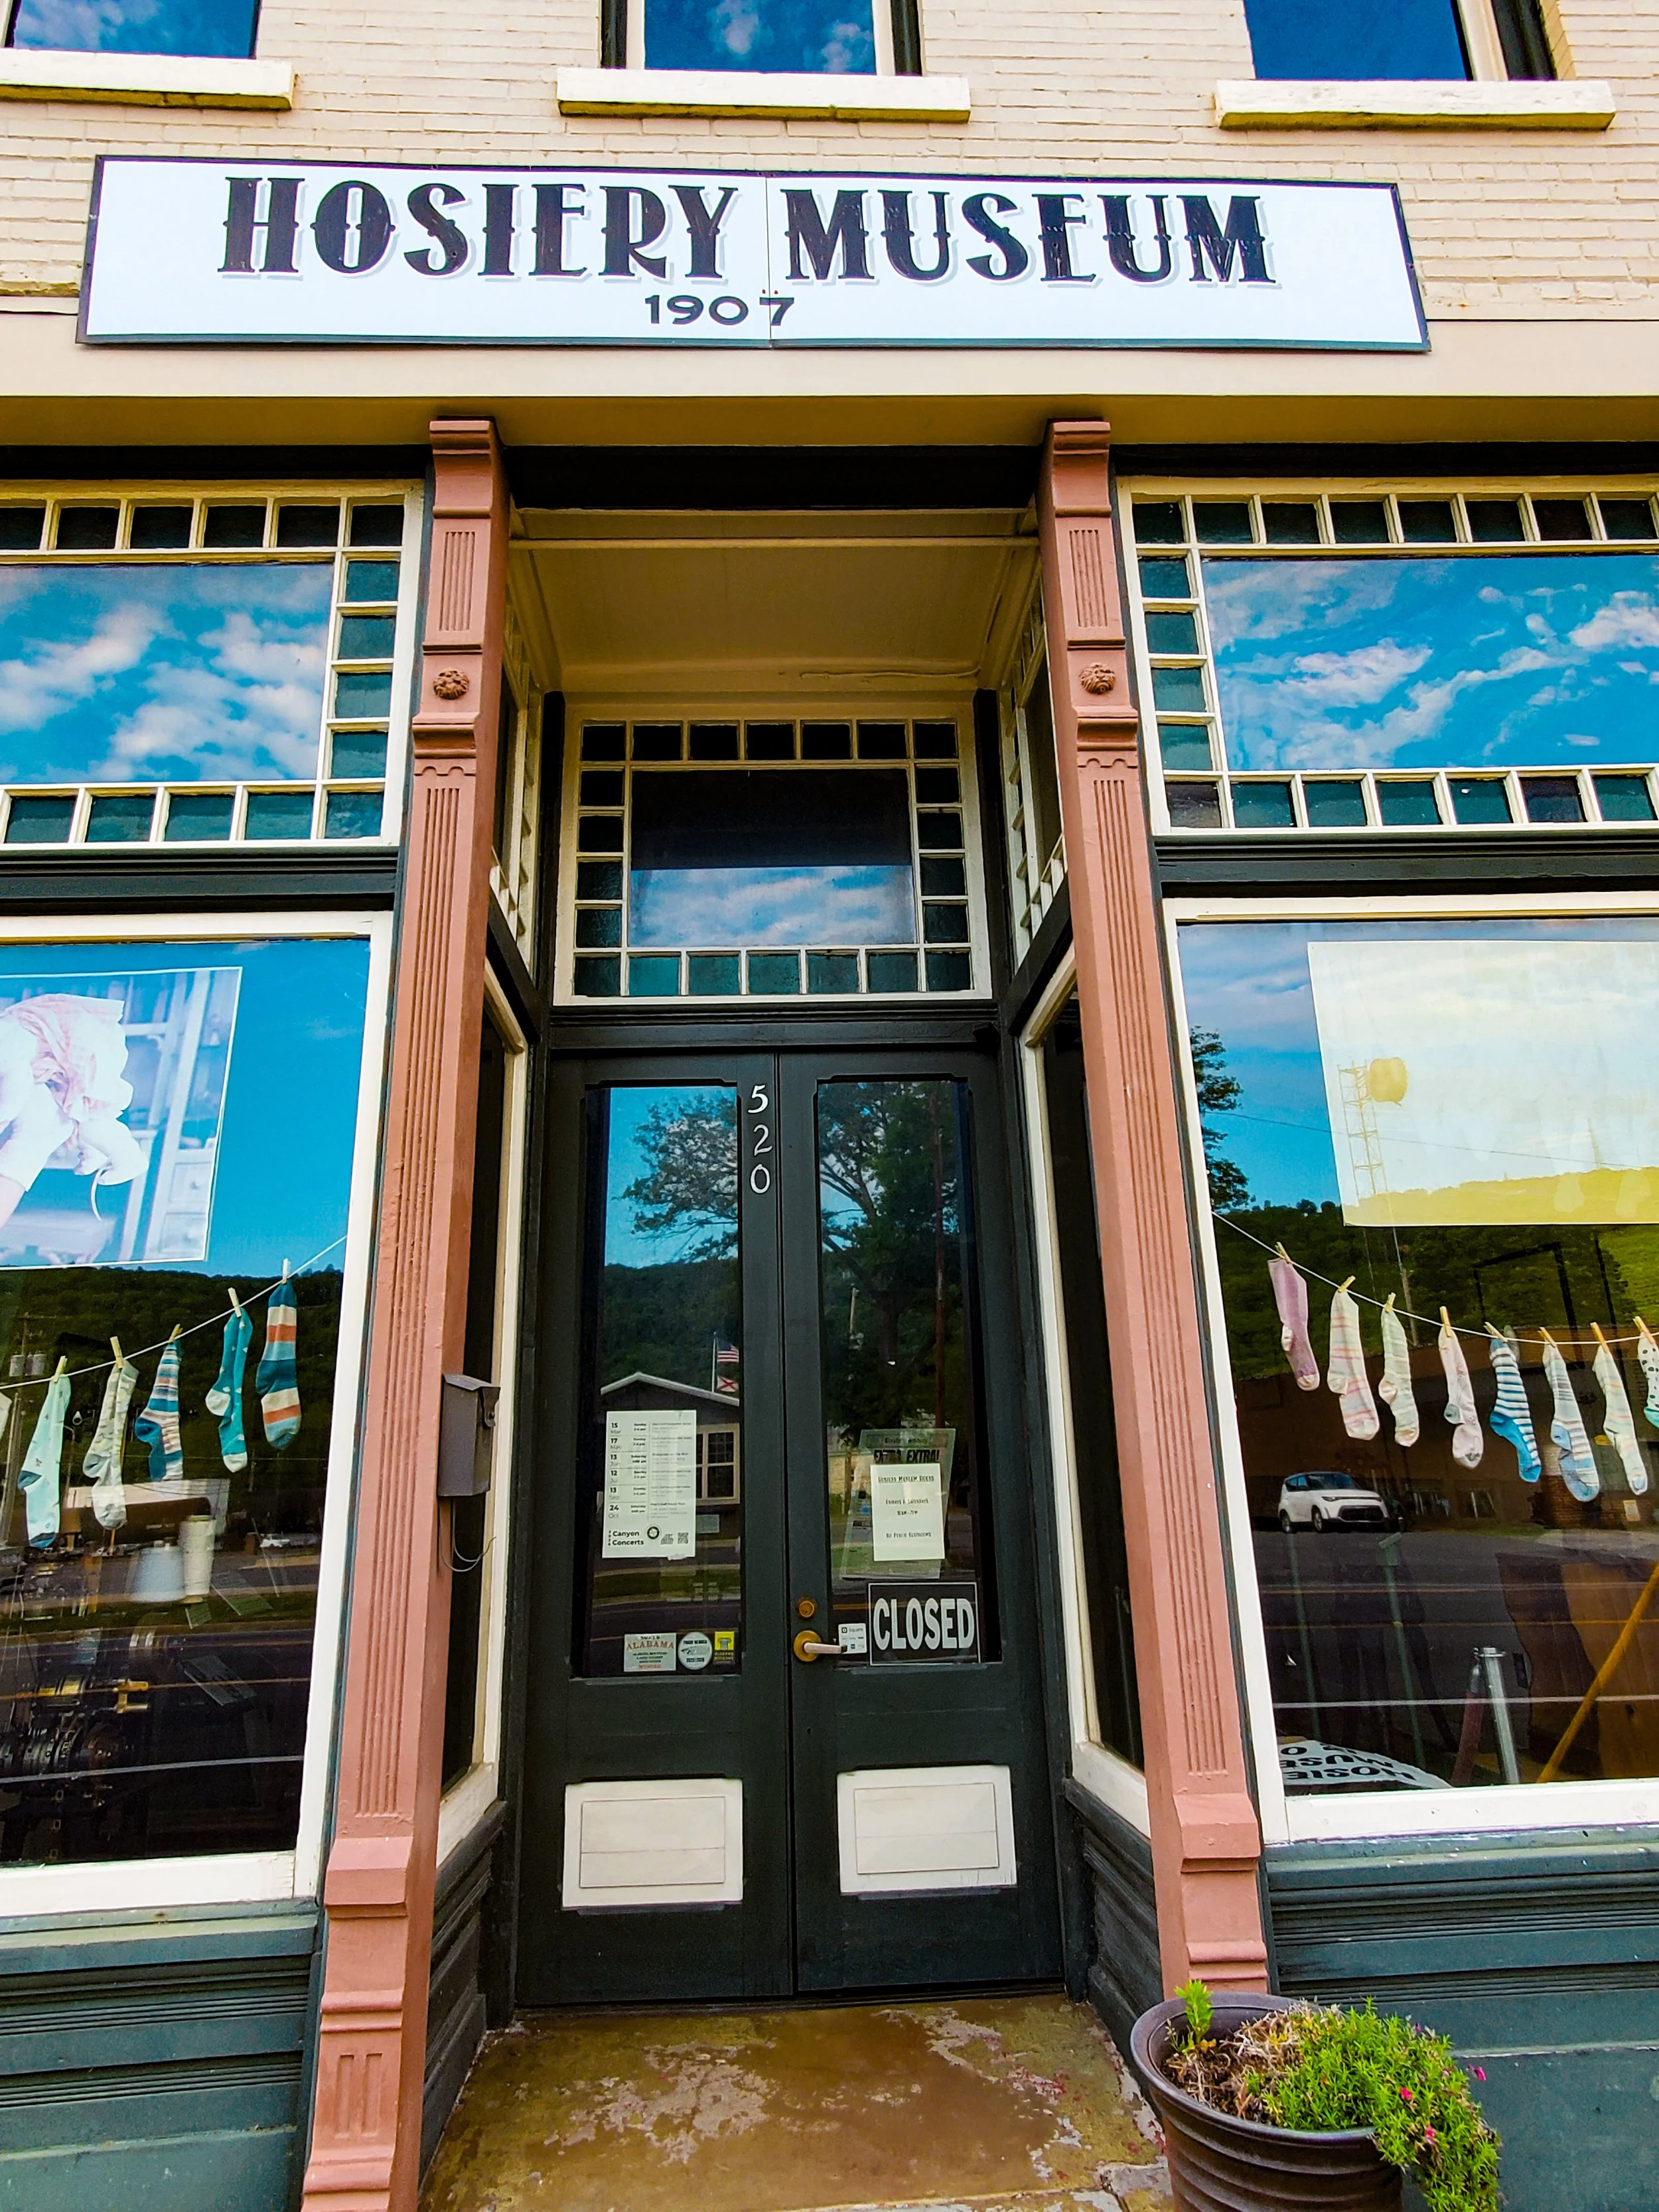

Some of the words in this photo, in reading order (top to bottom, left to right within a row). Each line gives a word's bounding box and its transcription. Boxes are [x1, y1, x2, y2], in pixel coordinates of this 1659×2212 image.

[218, 177, 739, 280] HOSIERY
[780, 189, 1277, 284] MUSEUM
[645, 294, 795, 327] 1907
[873, 1597, 975, 1651] CLOSED
[626, 1641, 674, 1651] ALABAMA
